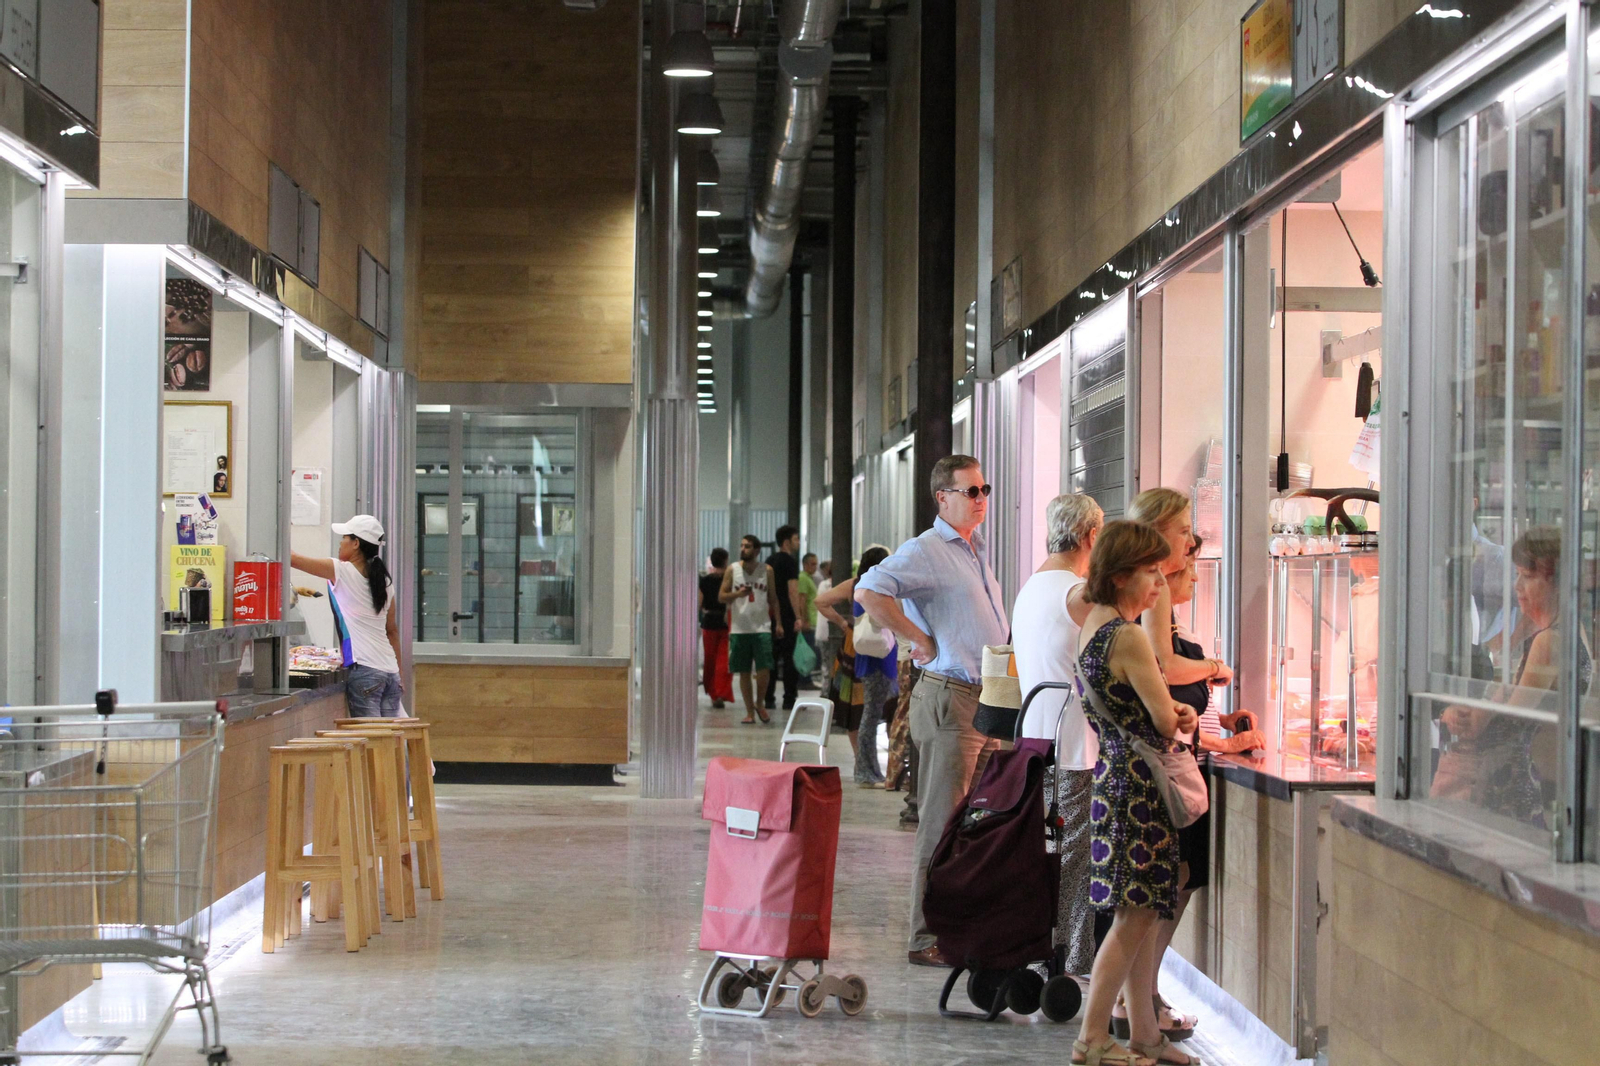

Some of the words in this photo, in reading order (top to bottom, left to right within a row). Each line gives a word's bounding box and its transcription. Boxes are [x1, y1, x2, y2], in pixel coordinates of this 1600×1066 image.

[180, 547, 199, 556] VINO
[201, 547, 212, 556] DE
[176, 556, 216, 566] CHUCENA
